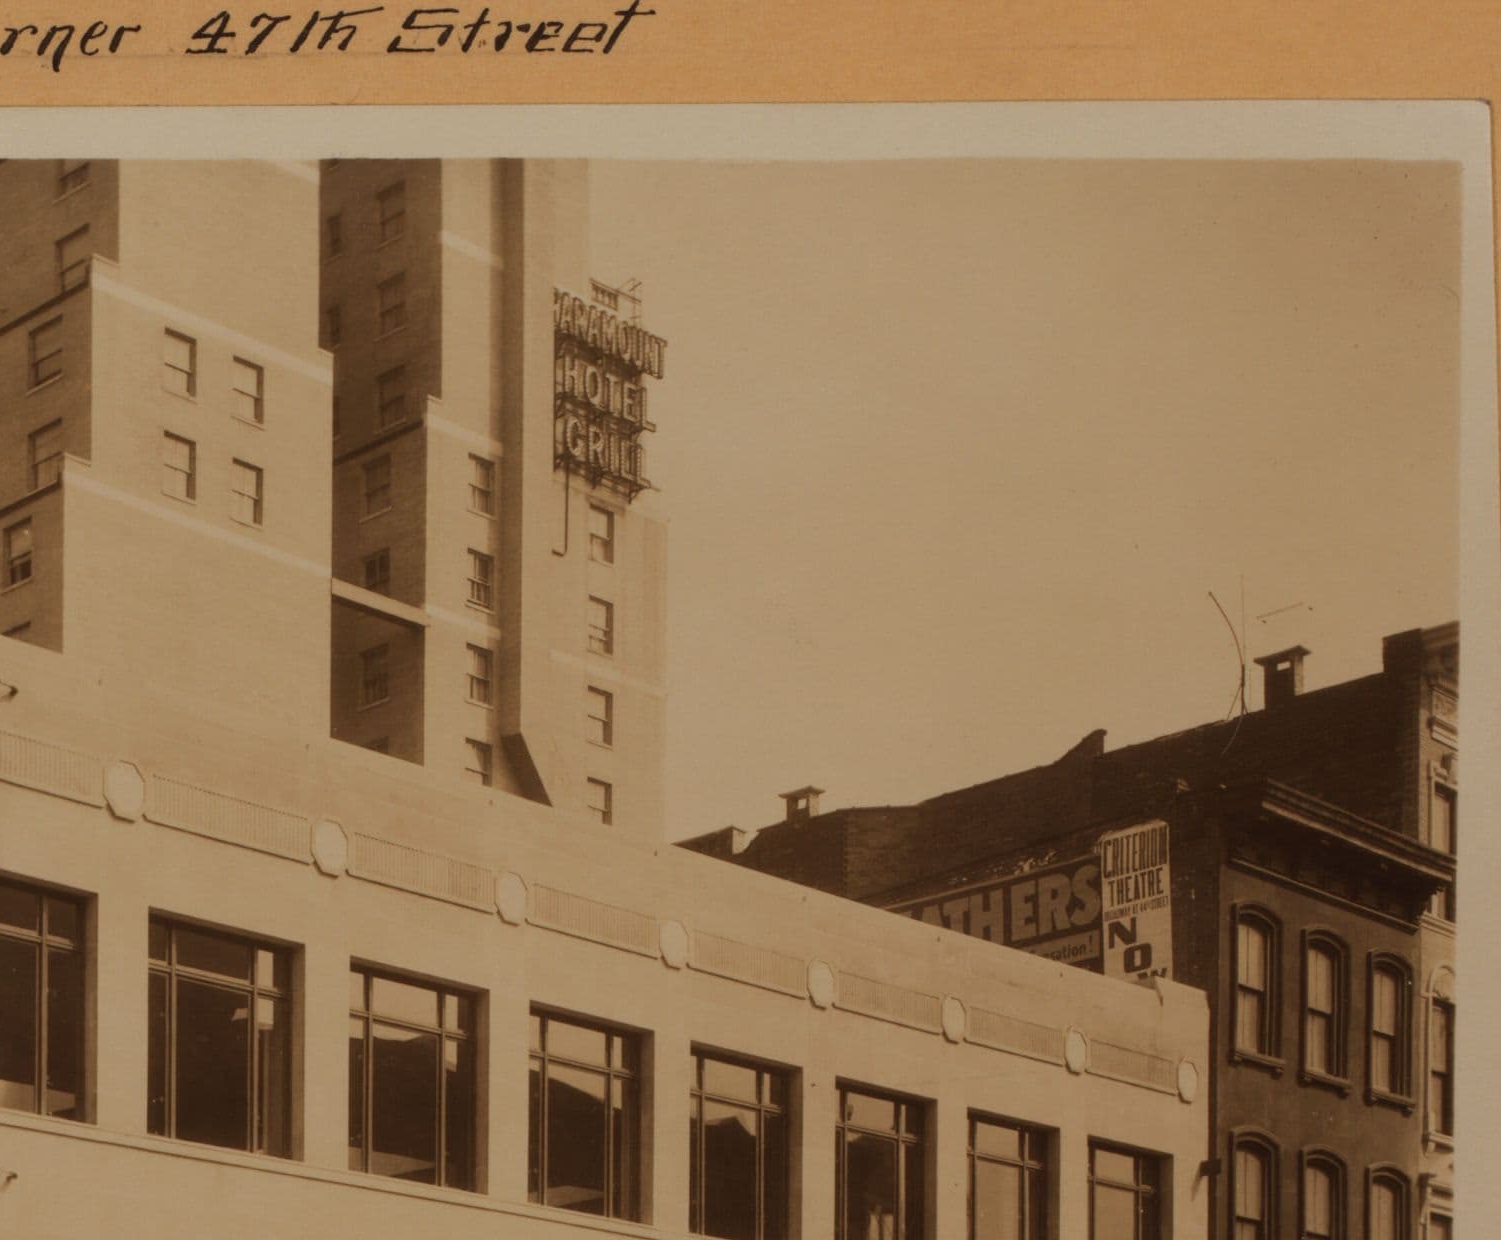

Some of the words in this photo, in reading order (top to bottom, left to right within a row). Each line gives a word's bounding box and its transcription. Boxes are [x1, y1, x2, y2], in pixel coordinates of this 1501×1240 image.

[387, 5, 656, 56] Street
[564, 353, 657, 433] HOTEL
[1104, 826, 1167, 878] CRITERION
[1108, 868, 1164, 907] THEATRE
